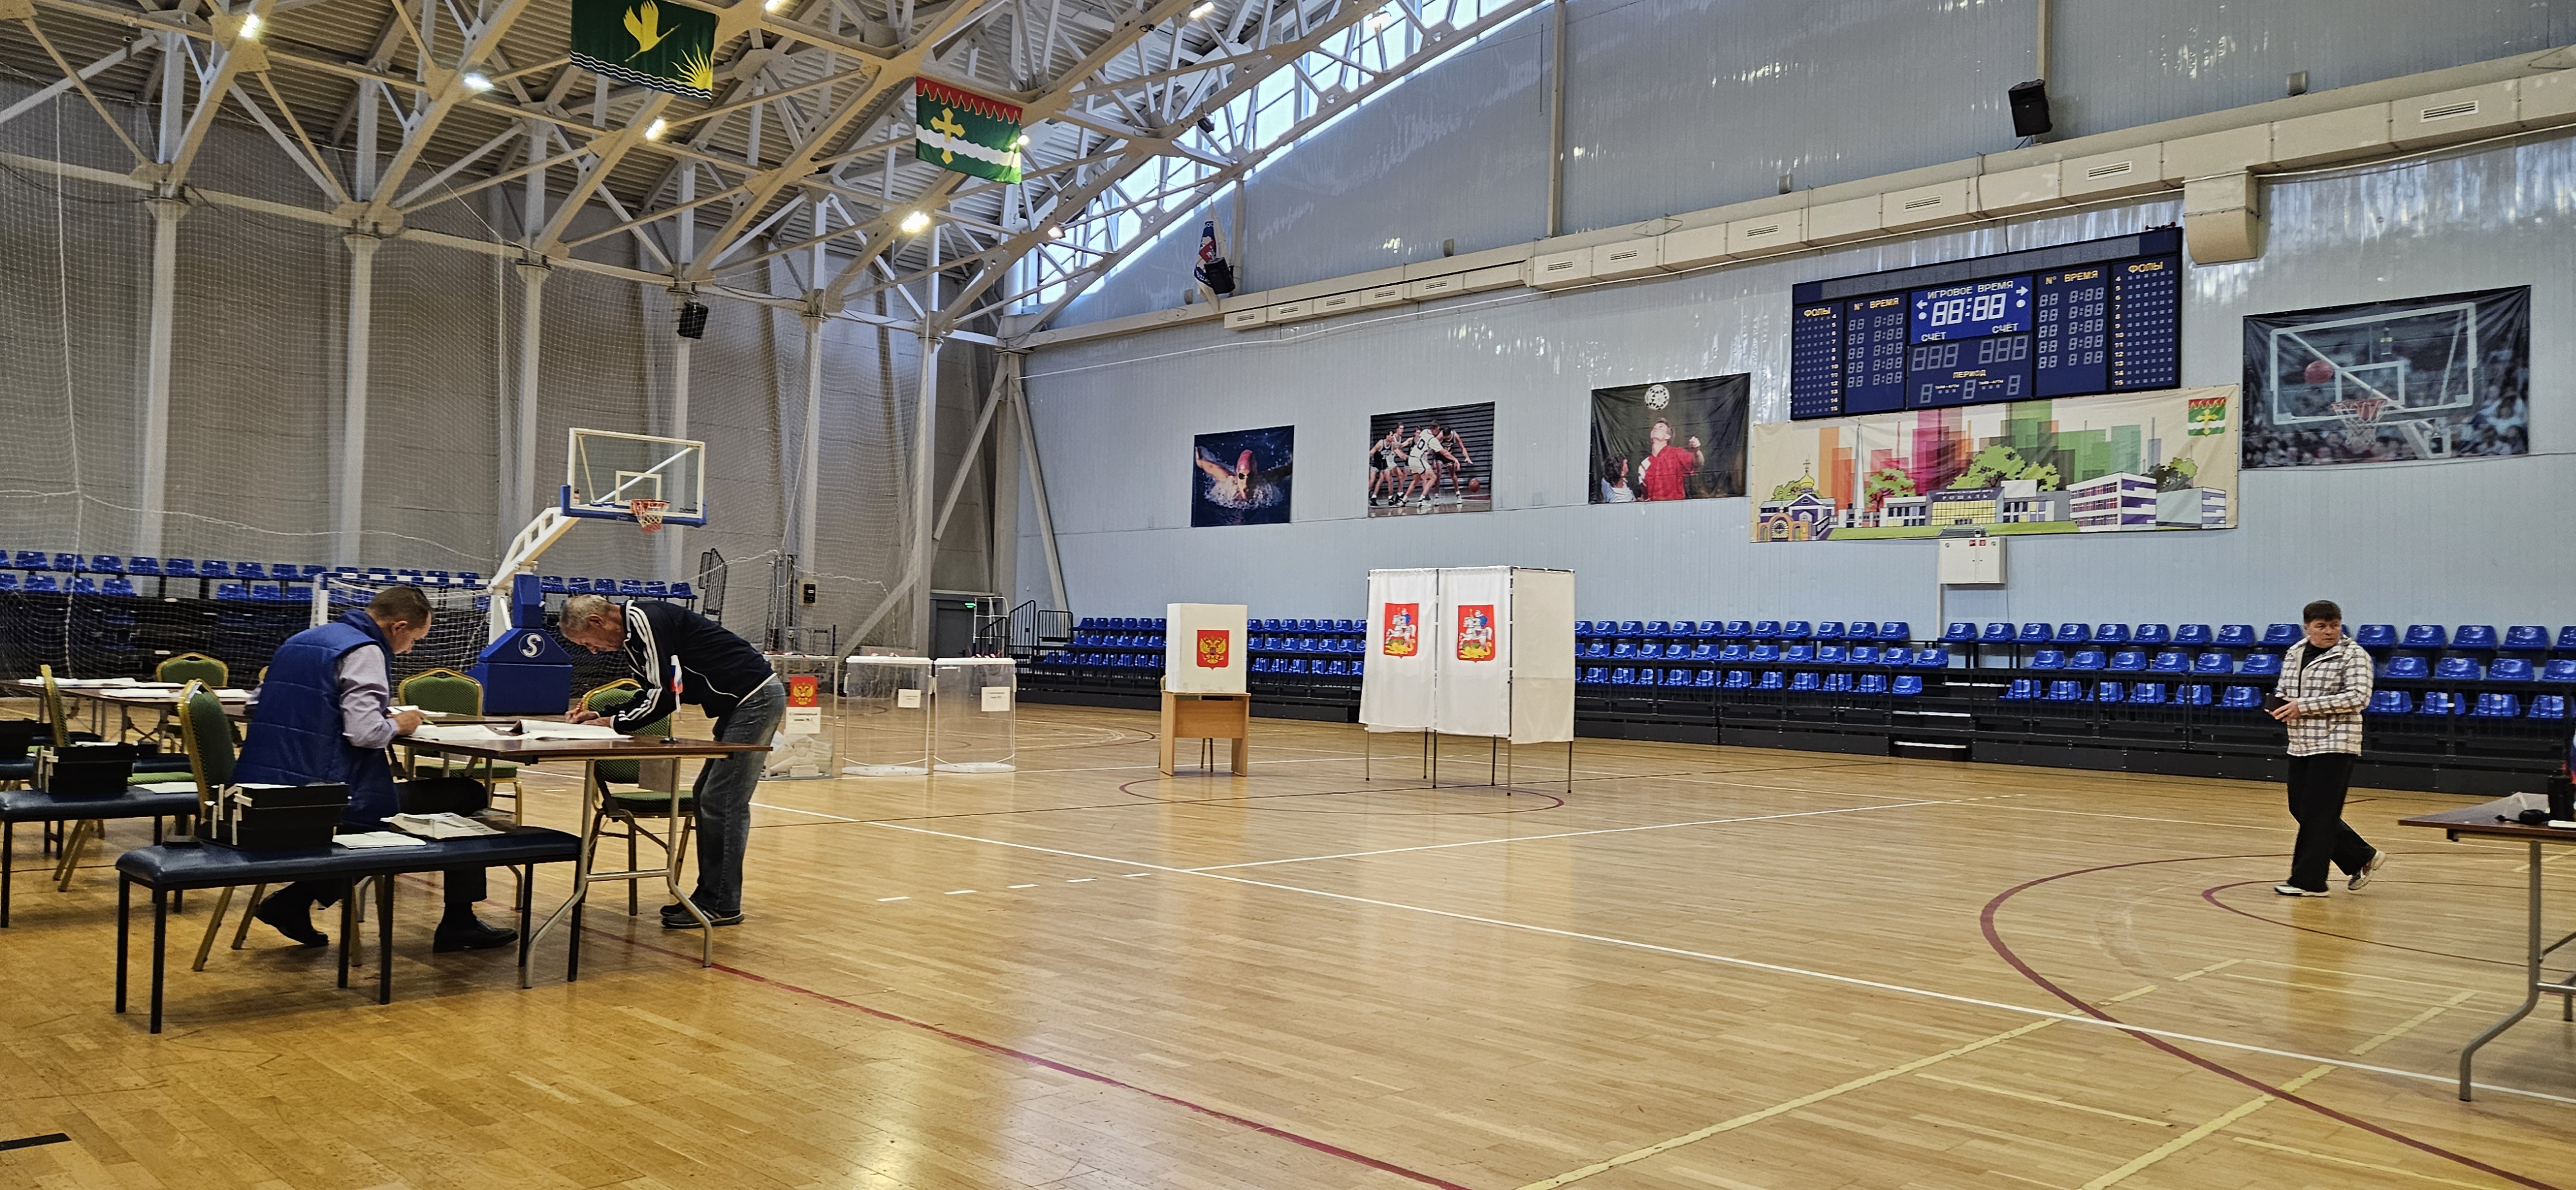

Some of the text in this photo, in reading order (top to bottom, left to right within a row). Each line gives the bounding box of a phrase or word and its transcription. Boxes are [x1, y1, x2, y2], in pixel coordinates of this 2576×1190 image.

[2128, 261, 2163, 274] ФОЛЫ
[2064, 270, 2098, 282] ВРЕМЯ
[1927, 280, 2014, 300] ИГРОВОЕ ВРЕМЯ
[1870, 298, 1899, 308] ВРЕМЯ
[1804, 307, 1831, 317] ФОЛЫ
[1991, 323, 2019, 334] СЧЁТ
[1921, 332, 1947, 342] СЧЁТ
[1953, 370, 1986, 379] ПЕРИОД
[522, 634, 542, 656] S
